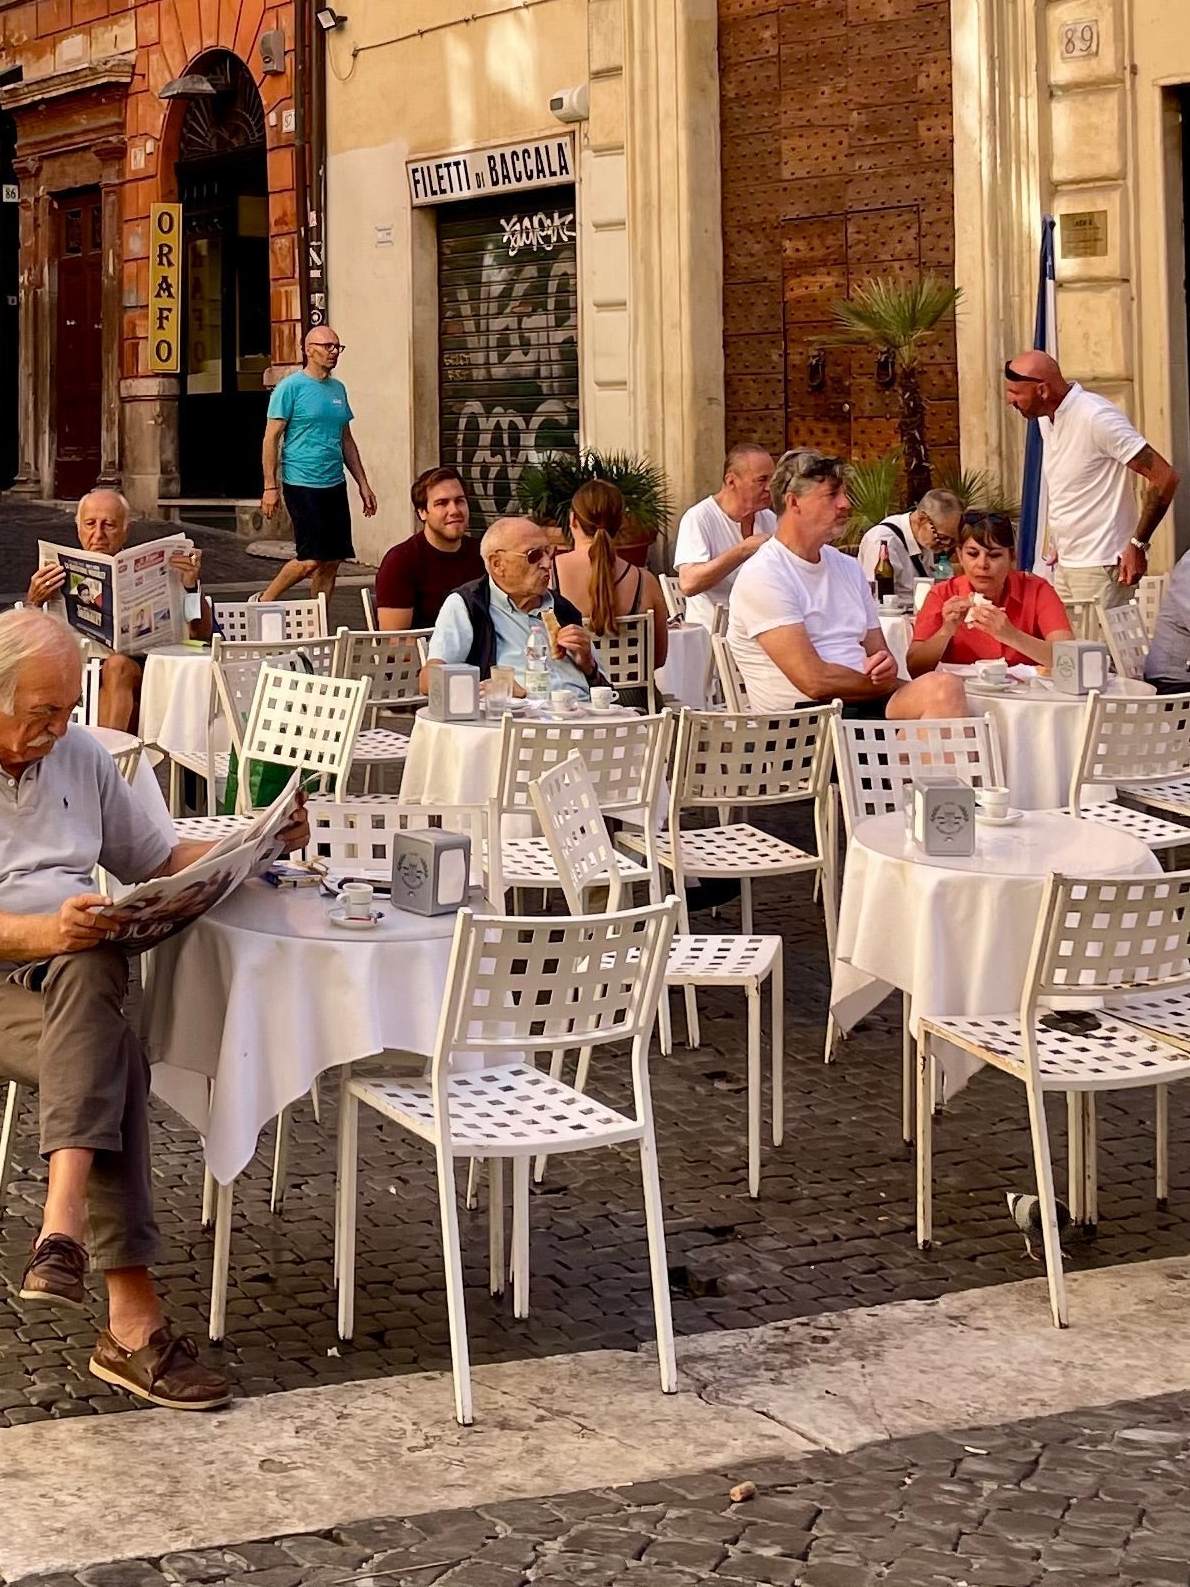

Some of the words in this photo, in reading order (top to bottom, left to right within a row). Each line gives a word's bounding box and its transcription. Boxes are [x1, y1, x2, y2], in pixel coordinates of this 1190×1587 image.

[1065, 24, 1093, 54] 89
[5, 187, 16, 199] 86
[411, 159, 471, 199] FILETTI
[475, 171, 486, 189] DI
[154, 211, 176, 363] ORAFO
